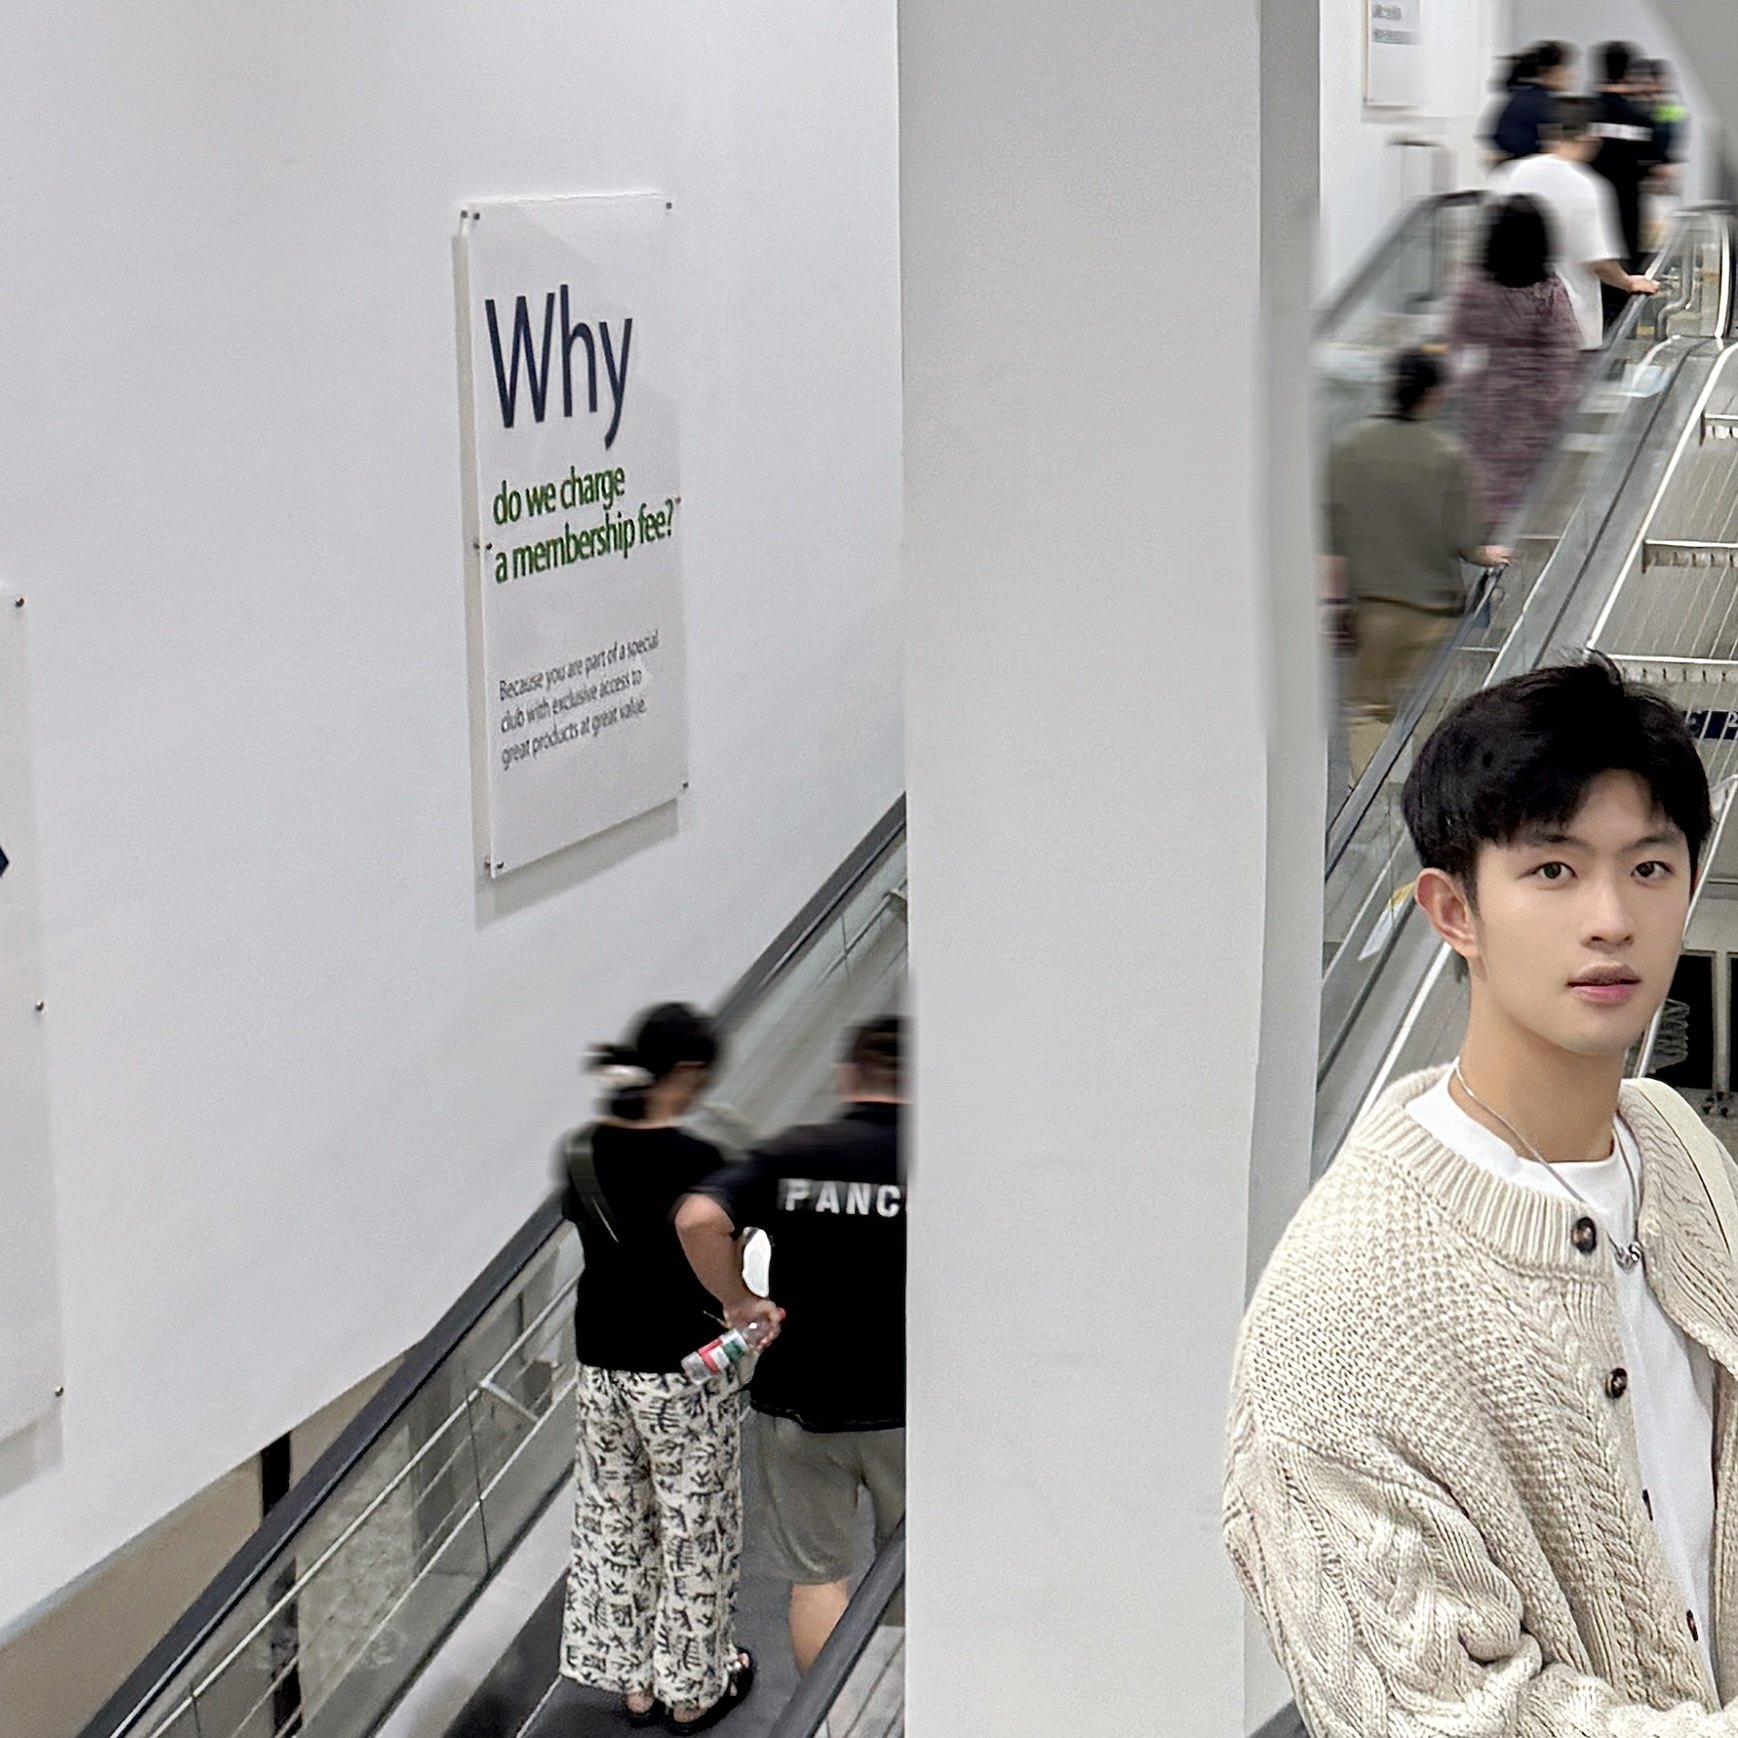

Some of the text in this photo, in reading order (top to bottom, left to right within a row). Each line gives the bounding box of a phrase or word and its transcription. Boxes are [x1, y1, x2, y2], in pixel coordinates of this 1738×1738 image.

[484, 284, 633, 450] Why
[493, 465, 625, 525] do we charge
[495, 499, 674, 584] a membership fee?
